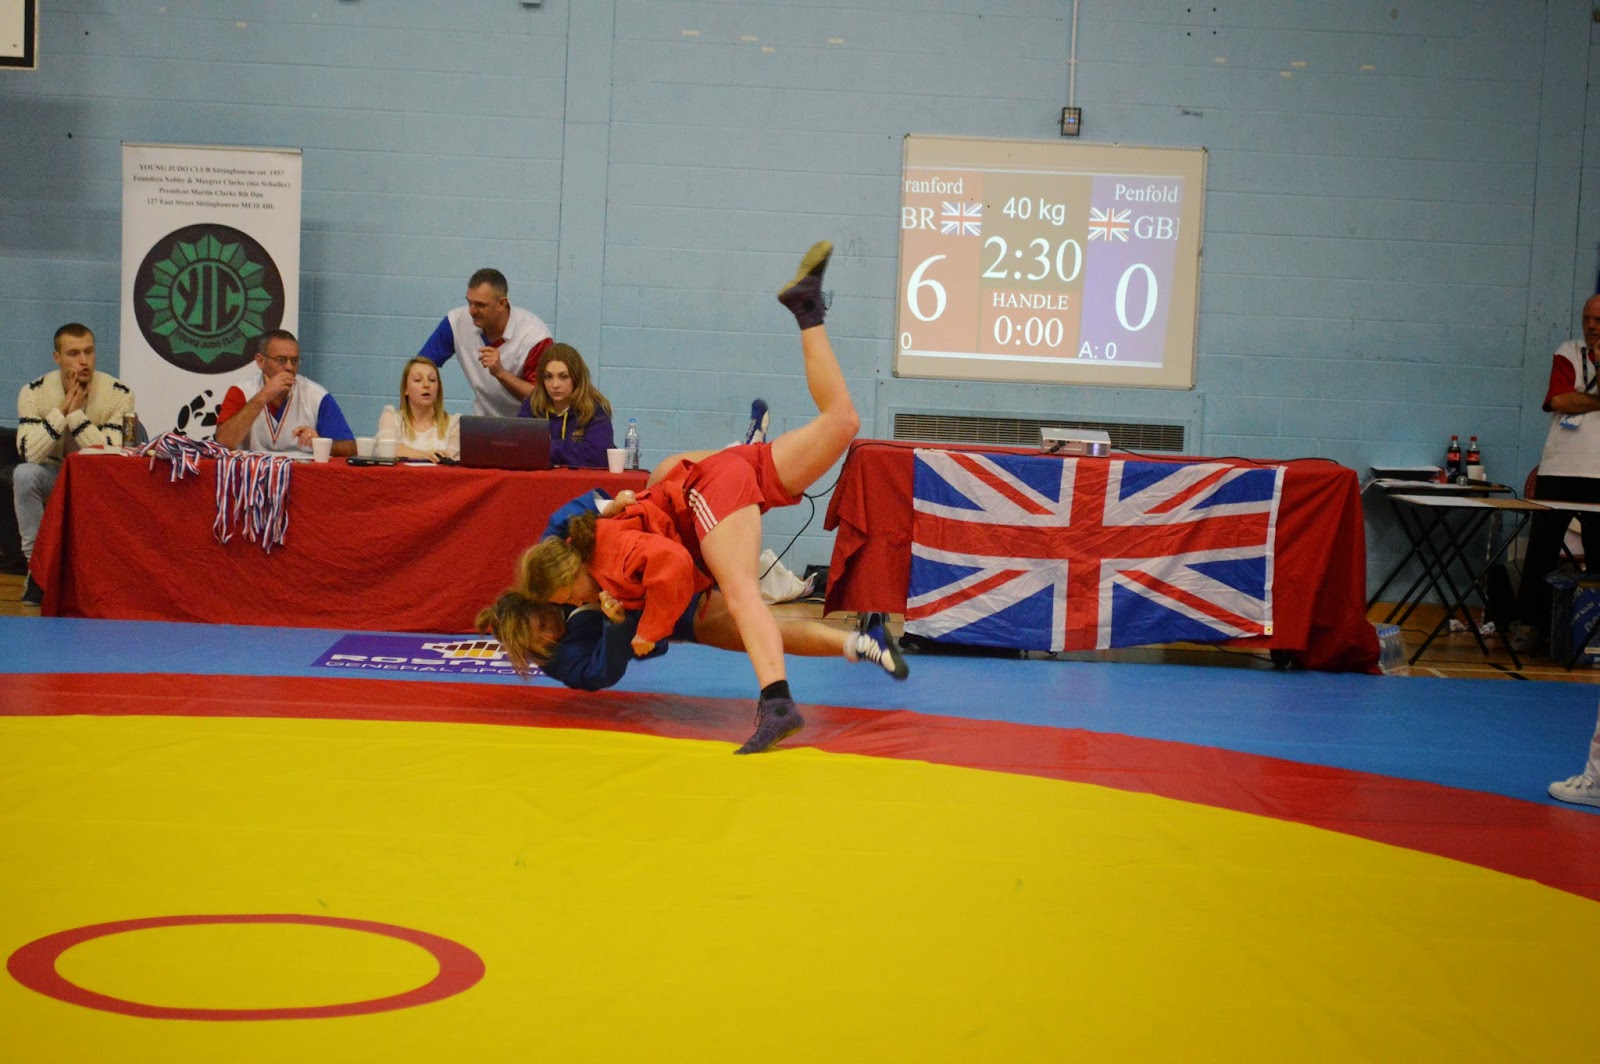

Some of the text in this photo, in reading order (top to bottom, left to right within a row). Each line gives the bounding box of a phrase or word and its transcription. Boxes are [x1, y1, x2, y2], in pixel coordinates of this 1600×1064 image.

[139, 164, 166, 172] YOUNG
[212, 167, 256, 176] Sittingbourne
[133, 175, 163, 183] Founders
[223, 179, 246, 187] Clarke
[902, 176, 963, 195] ranford
[159, 187, 189, 196] President
[190, 188, 214, 196] Martin
[1114, 184, 1178, 203] Penfold
[196, 200, 240, 210] Sittingbourne
[1002, 196, 1066, 226] 40 kg
[902, 206, 937, 230] BR
[982, 236, 1082, 282] 2:30
[906, 254, 946, 322] 6
[1115, 262, 1158, 331] 0
[992, 292, 1069, 310] HANDLE
[900, 332, 912, 350] 0
[993, 316, 1064, 348] 0:00
[1078, 342, 1117, 360] A: 0
[325, 661, 547, 676] GENERAL SPON
